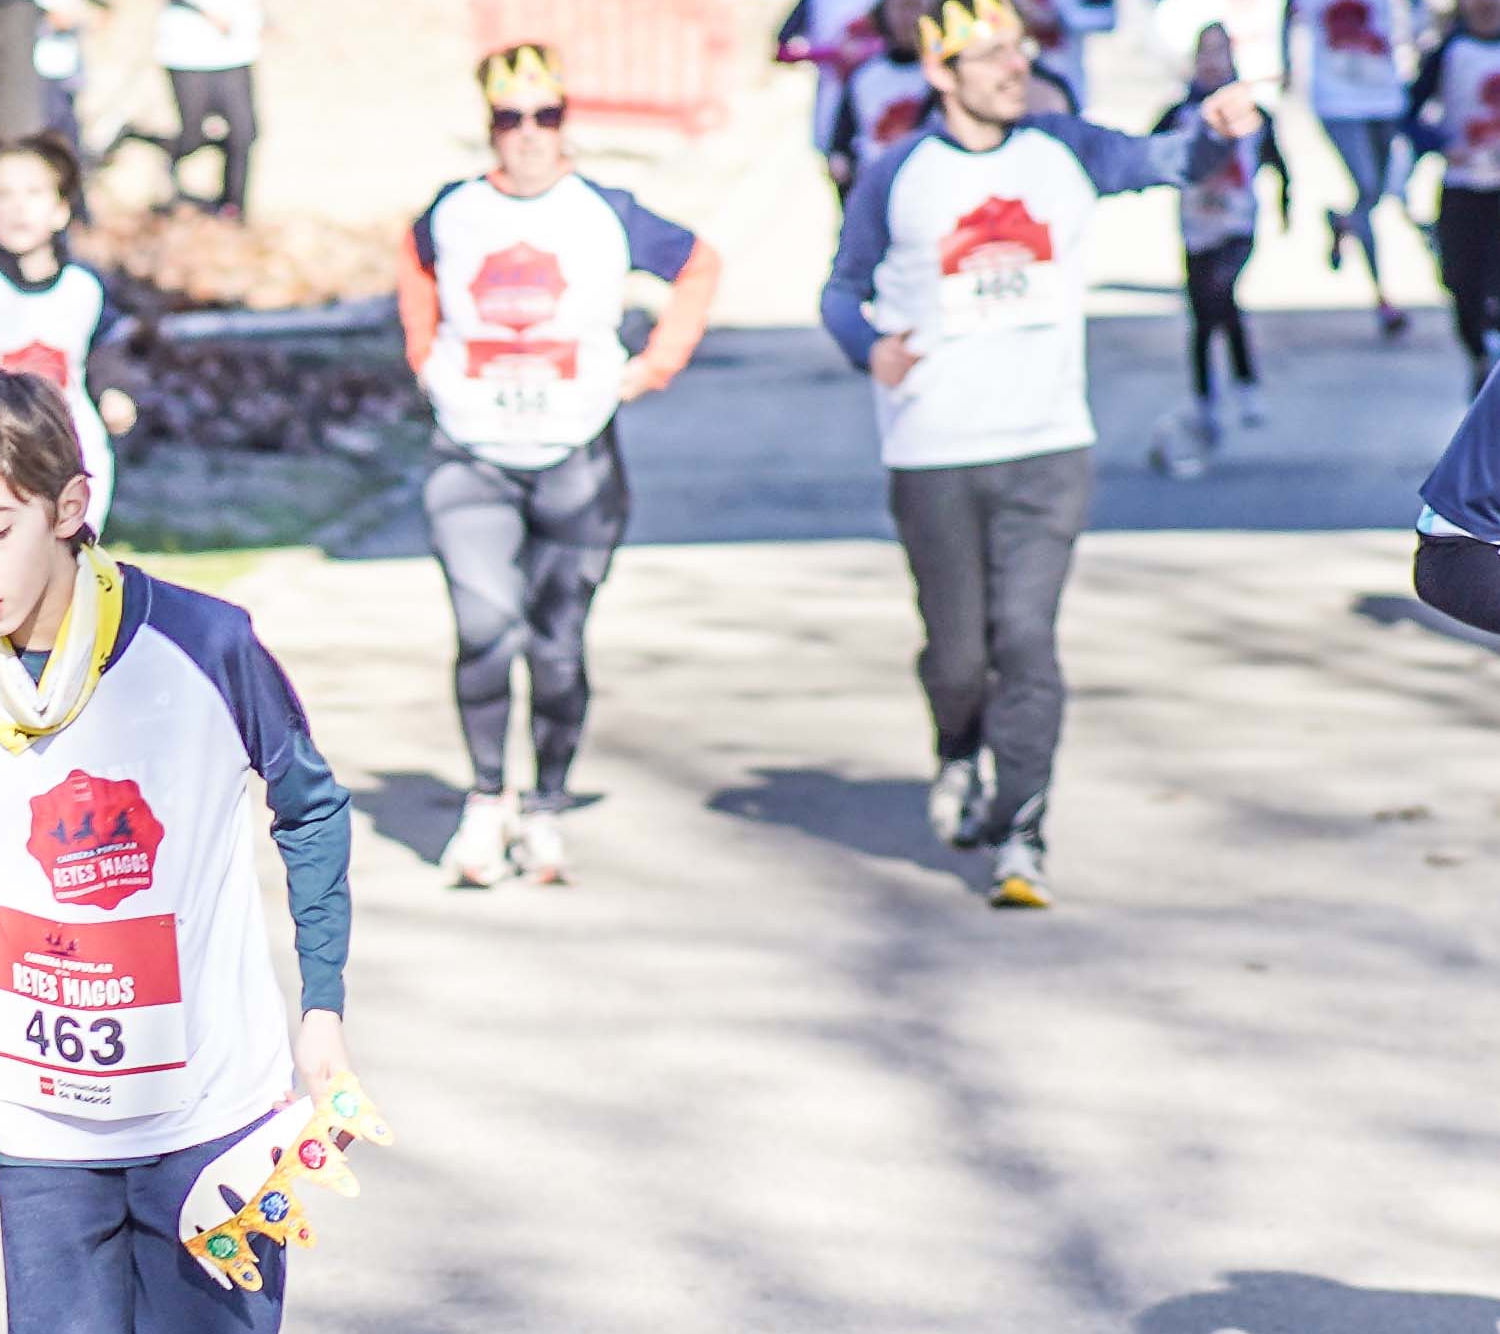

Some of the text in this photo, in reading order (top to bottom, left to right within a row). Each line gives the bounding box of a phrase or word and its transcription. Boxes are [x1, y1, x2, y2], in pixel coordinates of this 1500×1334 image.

[12, 962, 135, 1008] REYES MAGOS
[26, 1010, 126, 1066] 463
